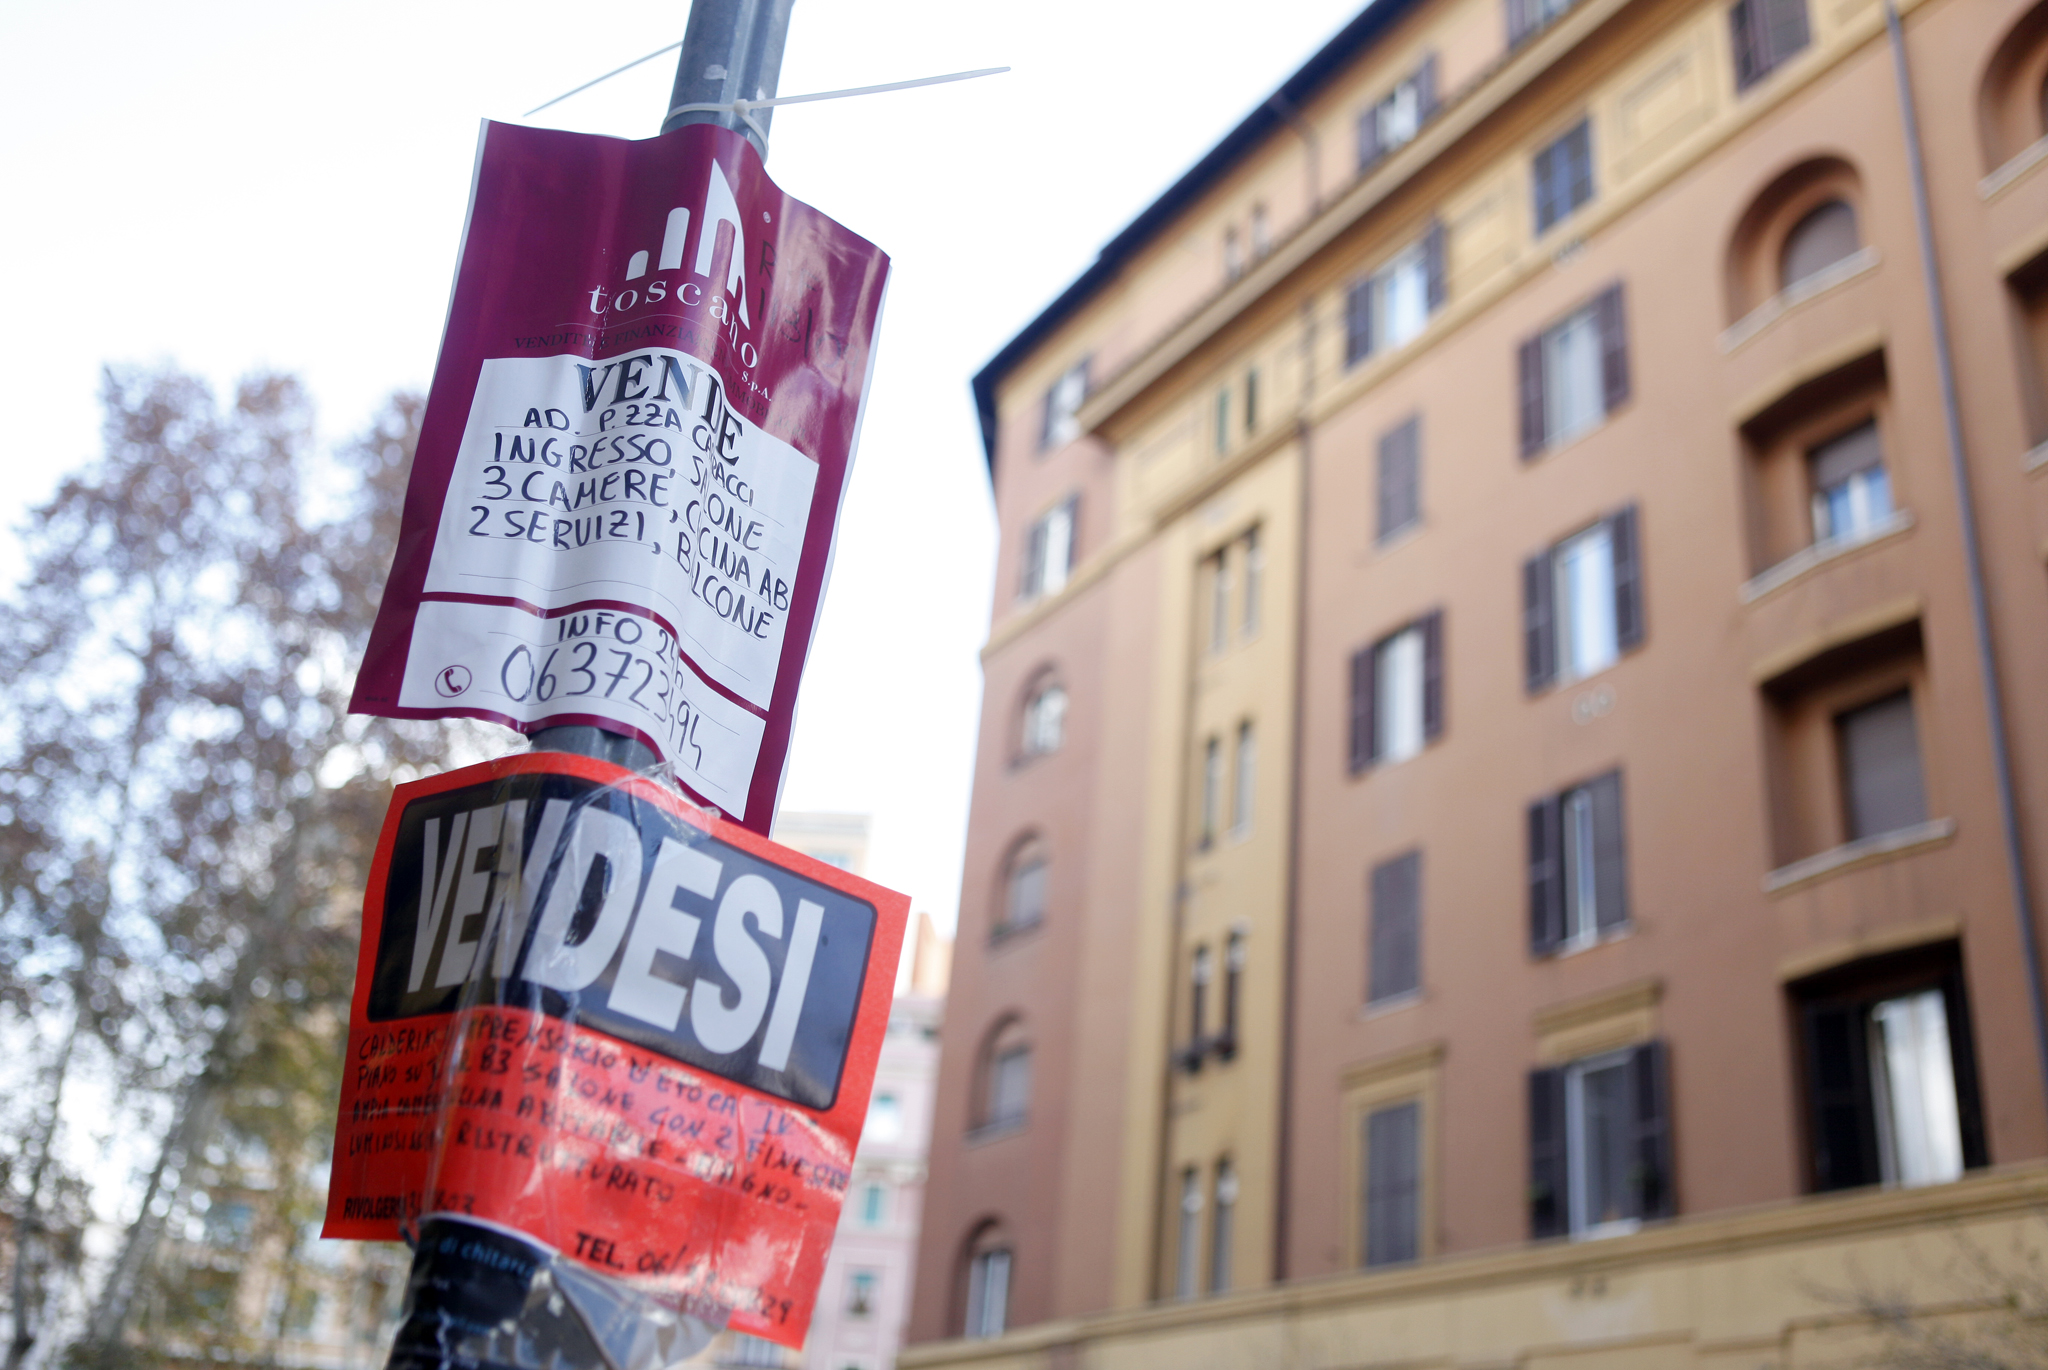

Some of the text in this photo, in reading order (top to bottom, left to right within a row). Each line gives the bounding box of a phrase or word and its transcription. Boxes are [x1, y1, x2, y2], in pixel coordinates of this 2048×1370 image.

[515, 332, 596, 349] VENDITE
[600, 337, 610, 349] E
[587, 279, 760, 369] toscano
[574, 354, 743, 467] VENDE
[759, 568, 790, 612] AB
[559, 612, 643, 645] INFO
[407, 799, 825, 1072] VENDESI
[357, 1062, 397, 1092] PIANO
[648, 1104, 706, 1138] CON
[575, 1231, 625, 1271] TEL.
